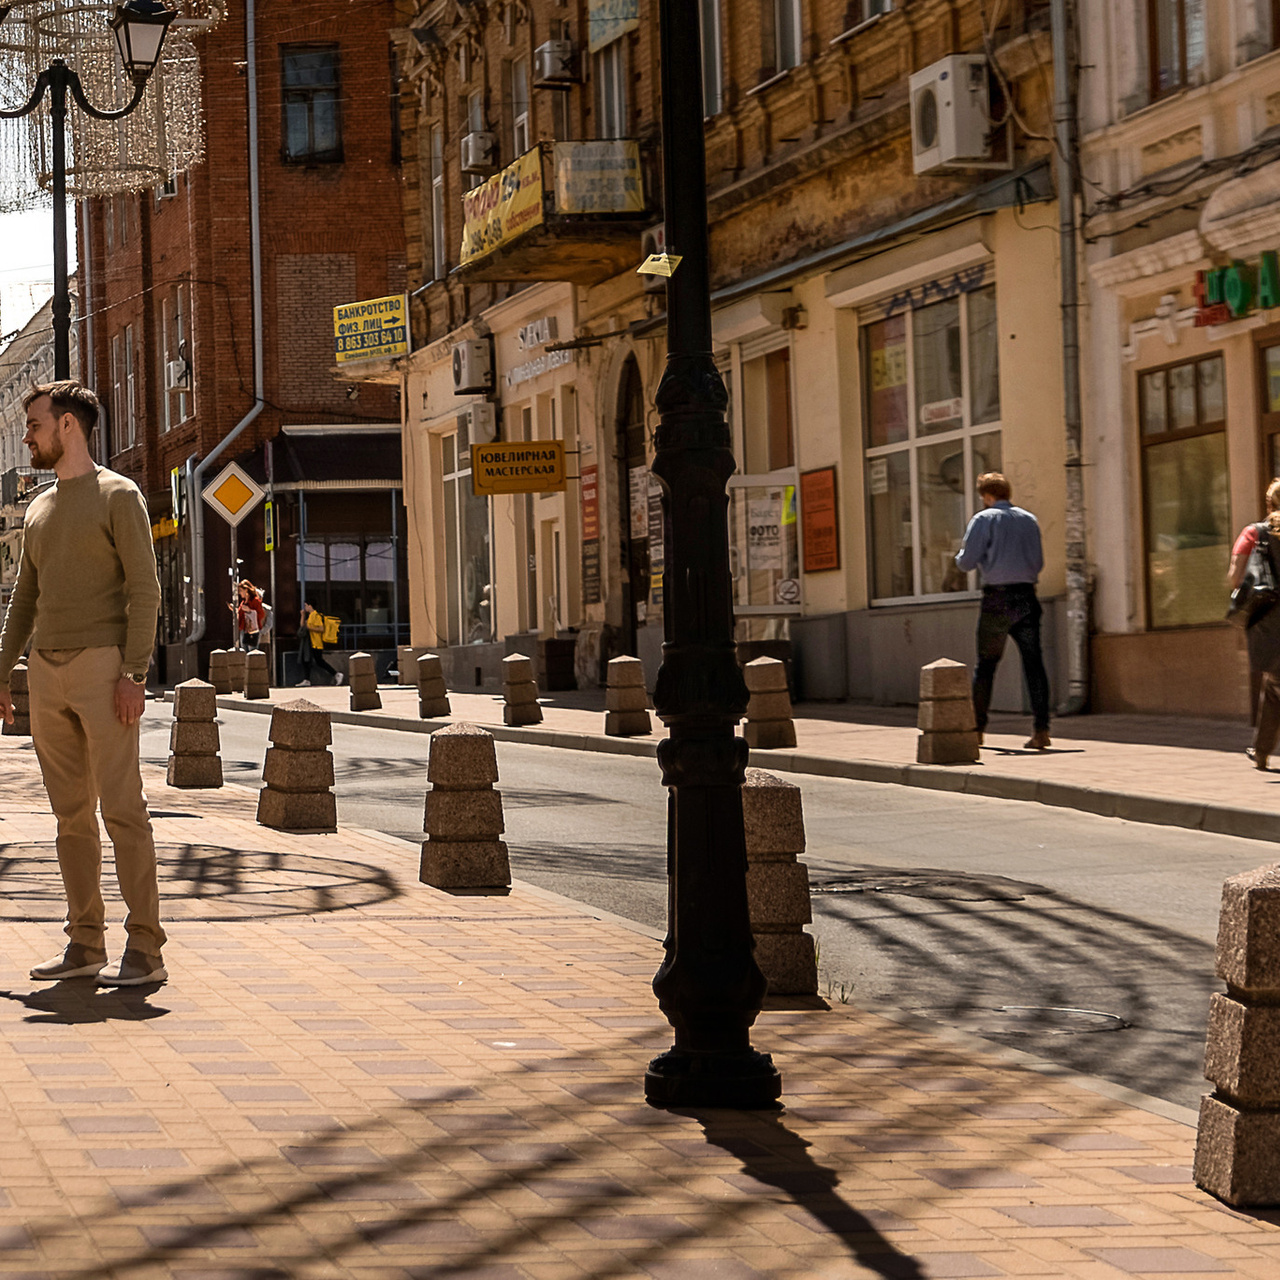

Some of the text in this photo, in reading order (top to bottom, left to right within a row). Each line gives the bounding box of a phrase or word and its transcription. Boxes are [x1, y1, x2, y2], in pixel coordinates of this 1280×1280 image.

[338, 299, 401, 320] БАНКРОТСТВО
[338, 318, 383, 335] ФИЗ. ЛИЦ
[338, 328, 403, 351] 8 863 303 64 10
[481, 450, 556, 463] ЮВЕЛИРНАЯ
[485, 465, 555, 476] МАСТЕРСКАЯ
[750, 524, 779, 536] ФОТО
